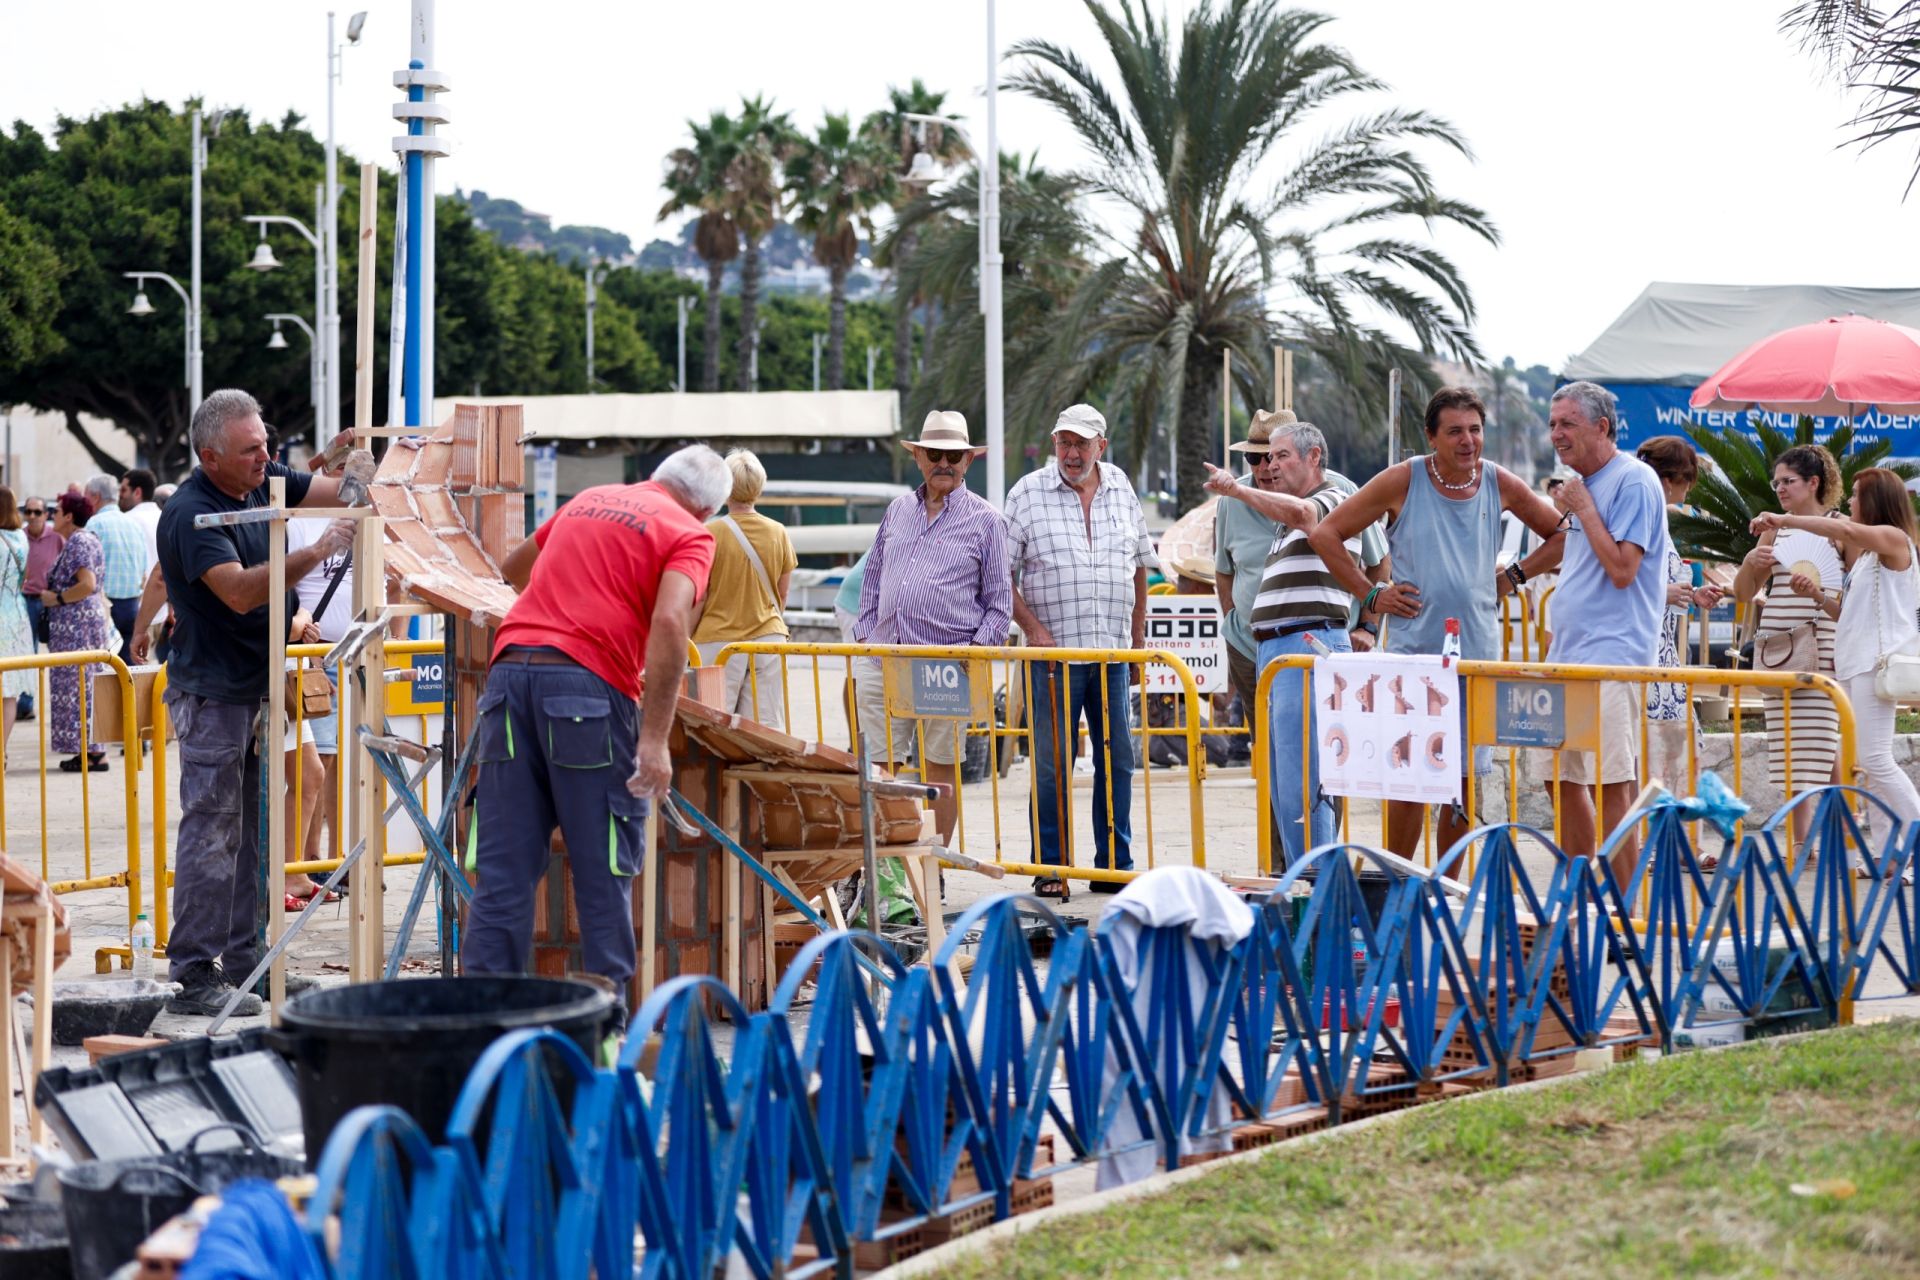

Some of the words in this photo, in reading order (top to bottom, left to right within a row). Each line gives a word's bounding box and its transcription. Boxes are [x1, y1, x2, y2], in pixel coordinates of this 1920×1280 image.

[1656, 407, 1736, 427] WINTER
[1147, 640, 1191, 648] acitana
[417, 665, 443, 681] MQ
[925, 664, 959, 689] MQ
[923, 692, 960, 702] Andamios
[1513, 687, 1553, 716] MQ
[1508, 719, 1553, 731] Andamios
